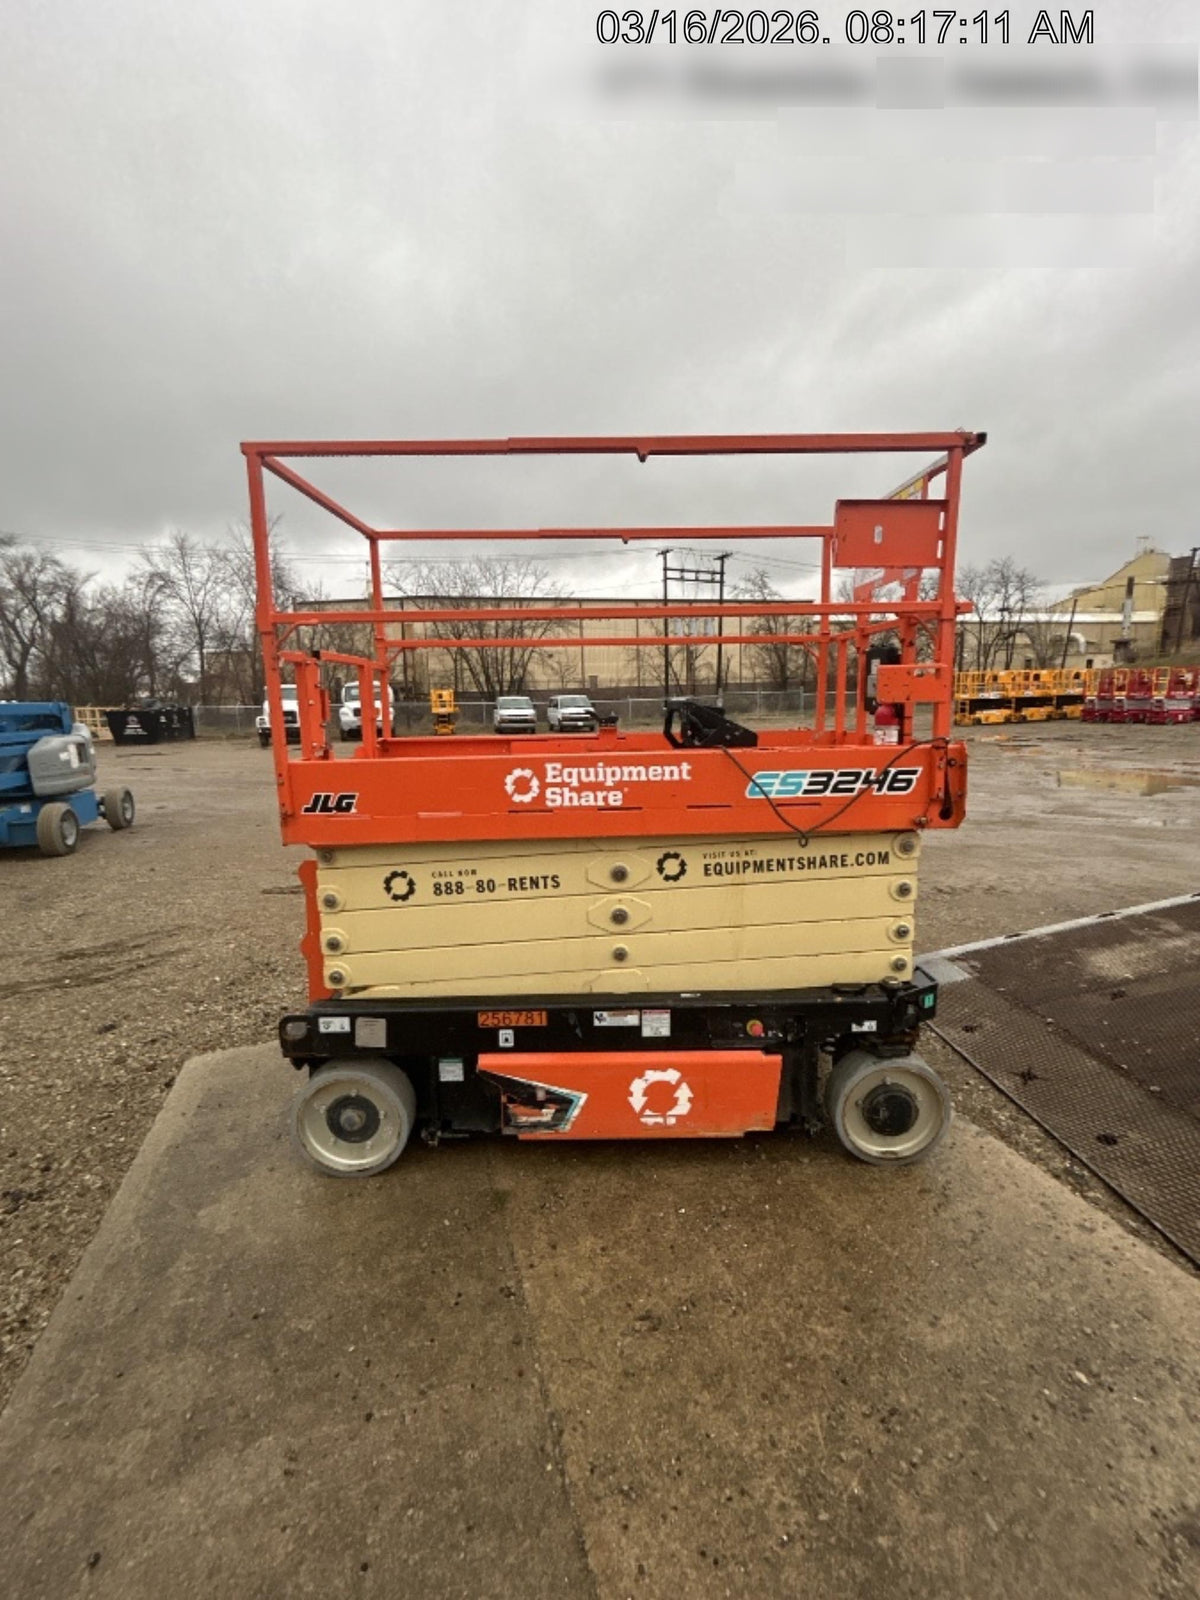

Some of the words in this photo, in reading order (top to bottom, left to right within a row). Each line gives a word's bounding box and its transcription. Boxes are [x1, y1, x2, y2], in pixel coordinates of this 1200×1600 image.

[545, 762, 691, 786] Equipment
[745, 768, 922, 798] ES3246
[302, 792, 358, 814] JLG
[545, 788, 623, 807] Share
[702, 851, 726, 860] VISIT
[730, 850, 741, 858] US
[703, 851, 890, 877] EQUIPMENTSHARE.COM
[431, 870, 454, 879] CALL
[458, 868, 478, 877] NOW
[479, 1011, 543, 1027] 256781
